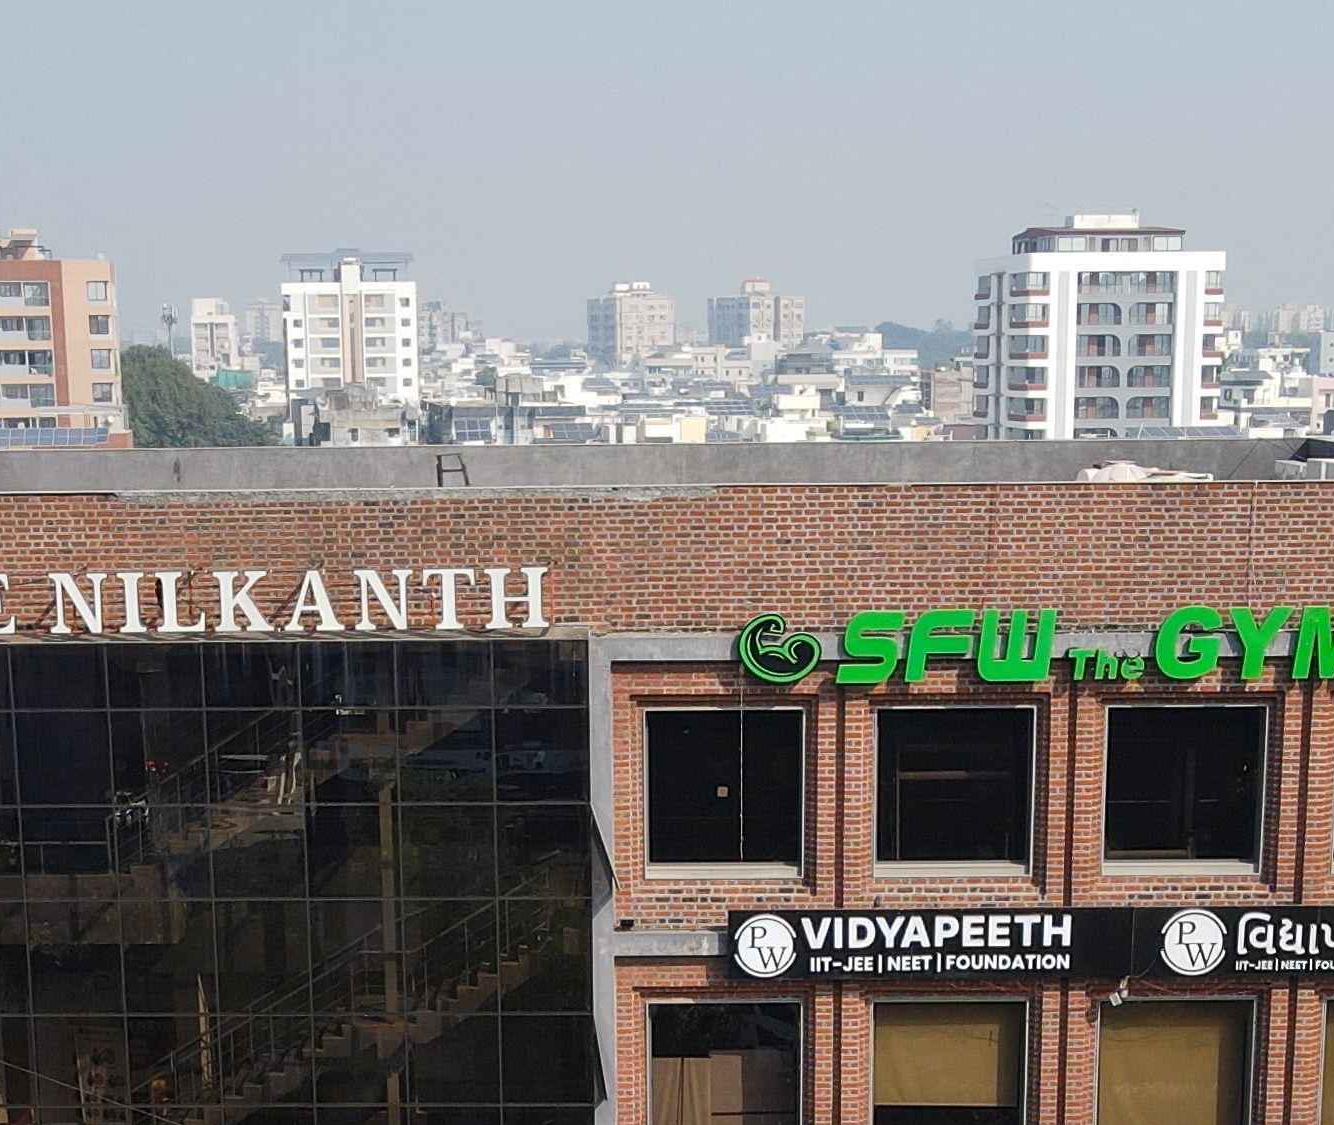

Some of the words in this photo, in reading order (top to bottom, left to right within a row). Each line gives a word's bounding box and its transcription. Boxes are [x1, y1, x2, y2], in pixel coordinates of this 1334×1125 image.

[48, 566, 552, 635] NILKANTH
[835, 608, 1057, 684] SFW
[1069, 648, 1146, 681] The
[800, 914, 1072, 949] VIDYAPEETH
[810, 955, 874, 973] IIT-JEE
[886, 955, 932, 972] NEET
[945, 953, 1070, 971] FOUNDATION
[1280, 959, 1308, 971] NEET
